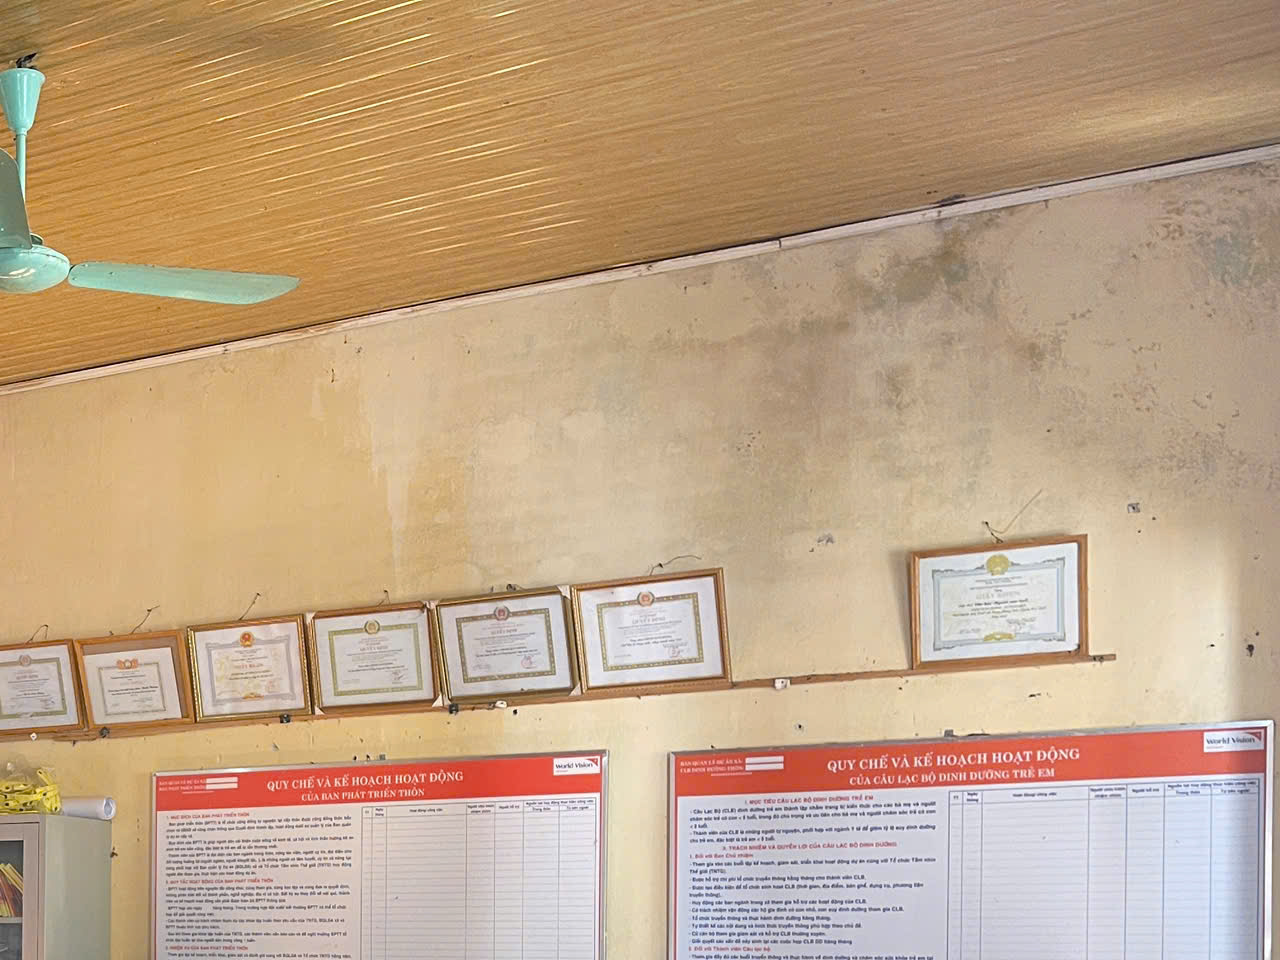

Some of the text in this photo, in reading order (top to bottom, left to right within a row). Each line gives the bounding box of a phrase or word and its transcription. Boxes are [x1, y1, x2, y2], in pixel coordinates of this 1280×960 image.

[1204, 734, 1257, 744] World Vision
[827, 746, 1080, 772] QUY CHẾ VÀ KẾ HOẠCH HOẠT ĐỘNG
[266, 770, 464, 791] QUY CHẾ VÀ KẾ HOẠCH HOẠT ĐỘNG
[849, 766, 1055, 785] CỦA CÂU LẠC BỘ DINH DƯỠNG TRẺ EM
[301, 786, 424, 801] CỦA BAN PHÁT TRIỂN THÔN
